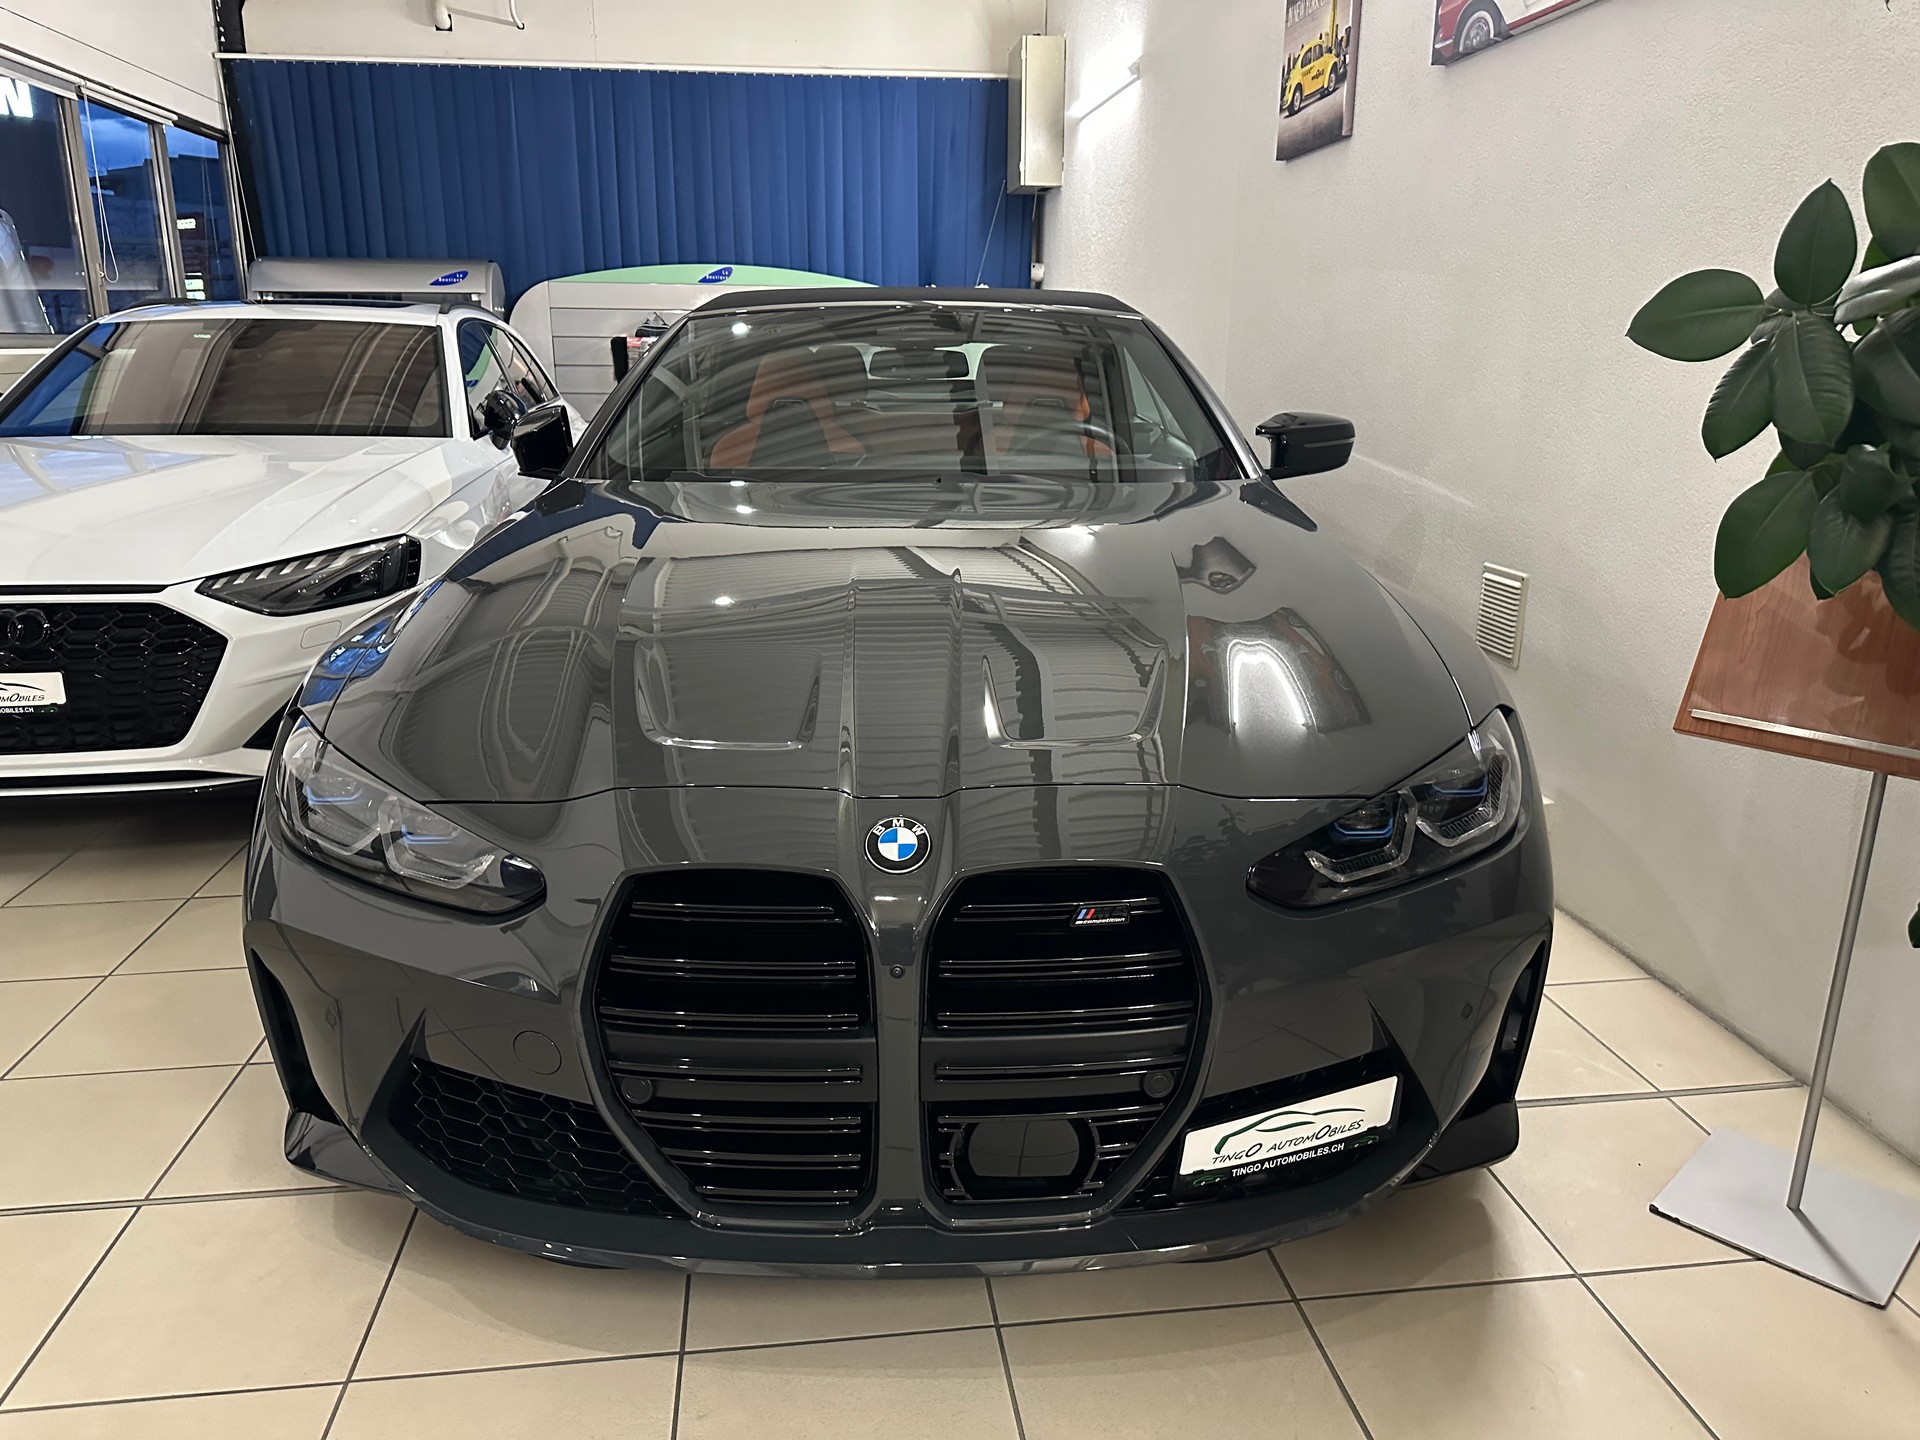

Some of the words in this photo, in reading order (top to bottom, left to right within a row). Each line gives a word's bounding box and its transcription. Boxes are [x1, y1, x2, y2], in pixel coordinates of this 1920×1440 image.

[872, 818, 925, 836] BMW
[1231, 1163, 1261, 1177] TINGO
[1261, 1142, 1345, 1170] AUTOMOBILES.CH
